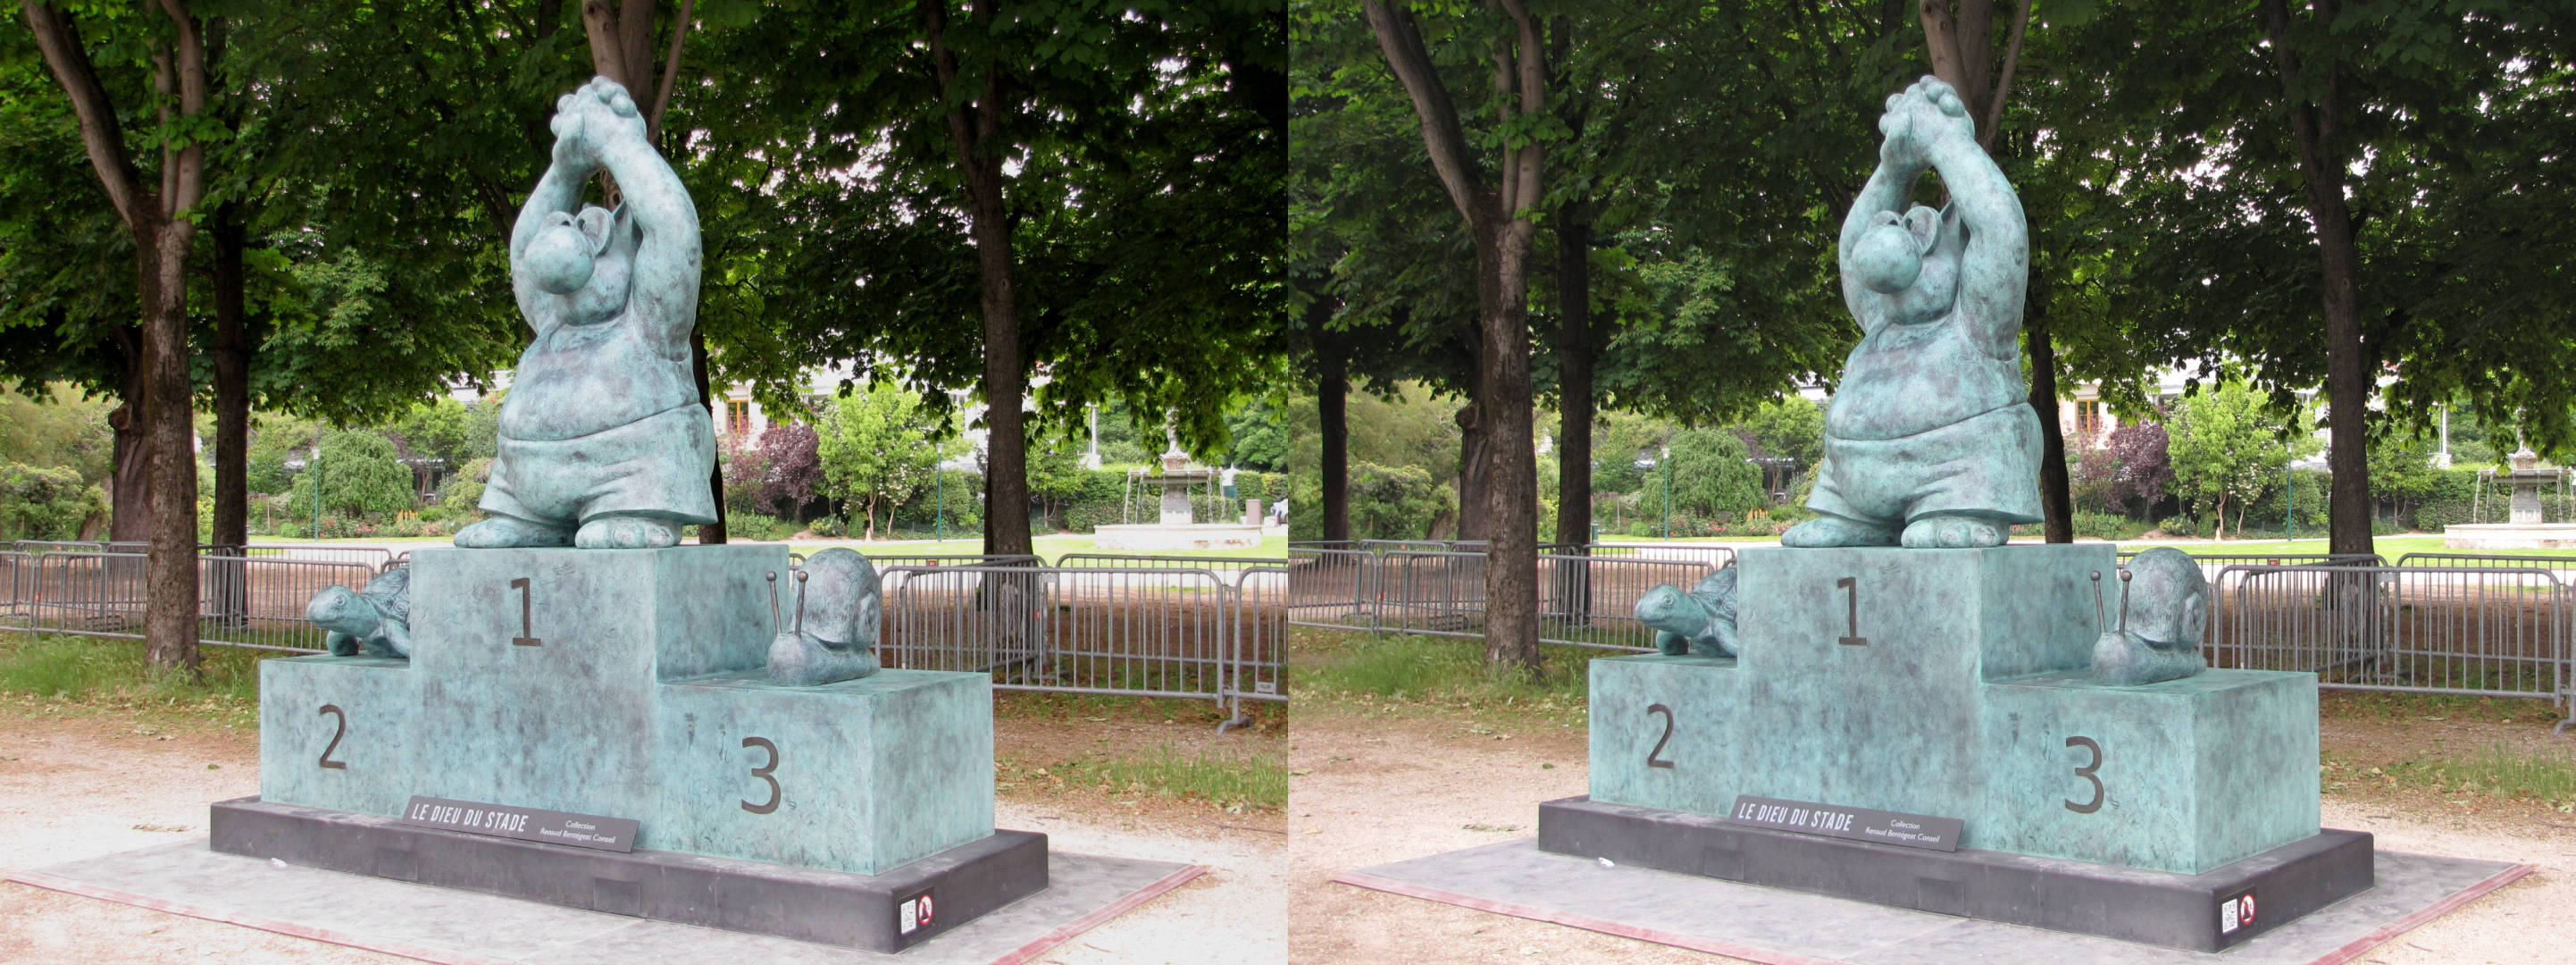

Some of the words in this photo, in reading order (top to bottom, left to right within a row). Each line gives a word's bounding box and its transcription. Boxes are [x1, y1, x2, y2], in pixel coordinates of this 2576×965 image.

[511, 577, 541, 647] 1
[1837, 577, 1868, 646] 1
[319, 704, 347, 770] 2
[1647, 703, 1675, 769] 2
[740, 736, 782, 814] 3
[2064, 735, 2104, 814] 3
[411, 803, 429, 820] LE
[431, 805, 463, 824] DIEU
[464, 809, 483, 827] DU
[485, 811, 529, 832] STADE
[539, 827, 563, 837] Renaud
[592, 833, 616, 843] Conseil
[565, 819, 596, 831] Collection
[1738, 802, 1756, 820] LE
[1757, 804, 1788, 824] DIEU
[1789, 808, 1809, 827] DU
[1811, 810, 1855, 832] STADE
[1865, 827, 1888, 836] Renaud
[1917, 833, 1941, 843] Conseil
[1890, 819, 1920, 830] Collection
